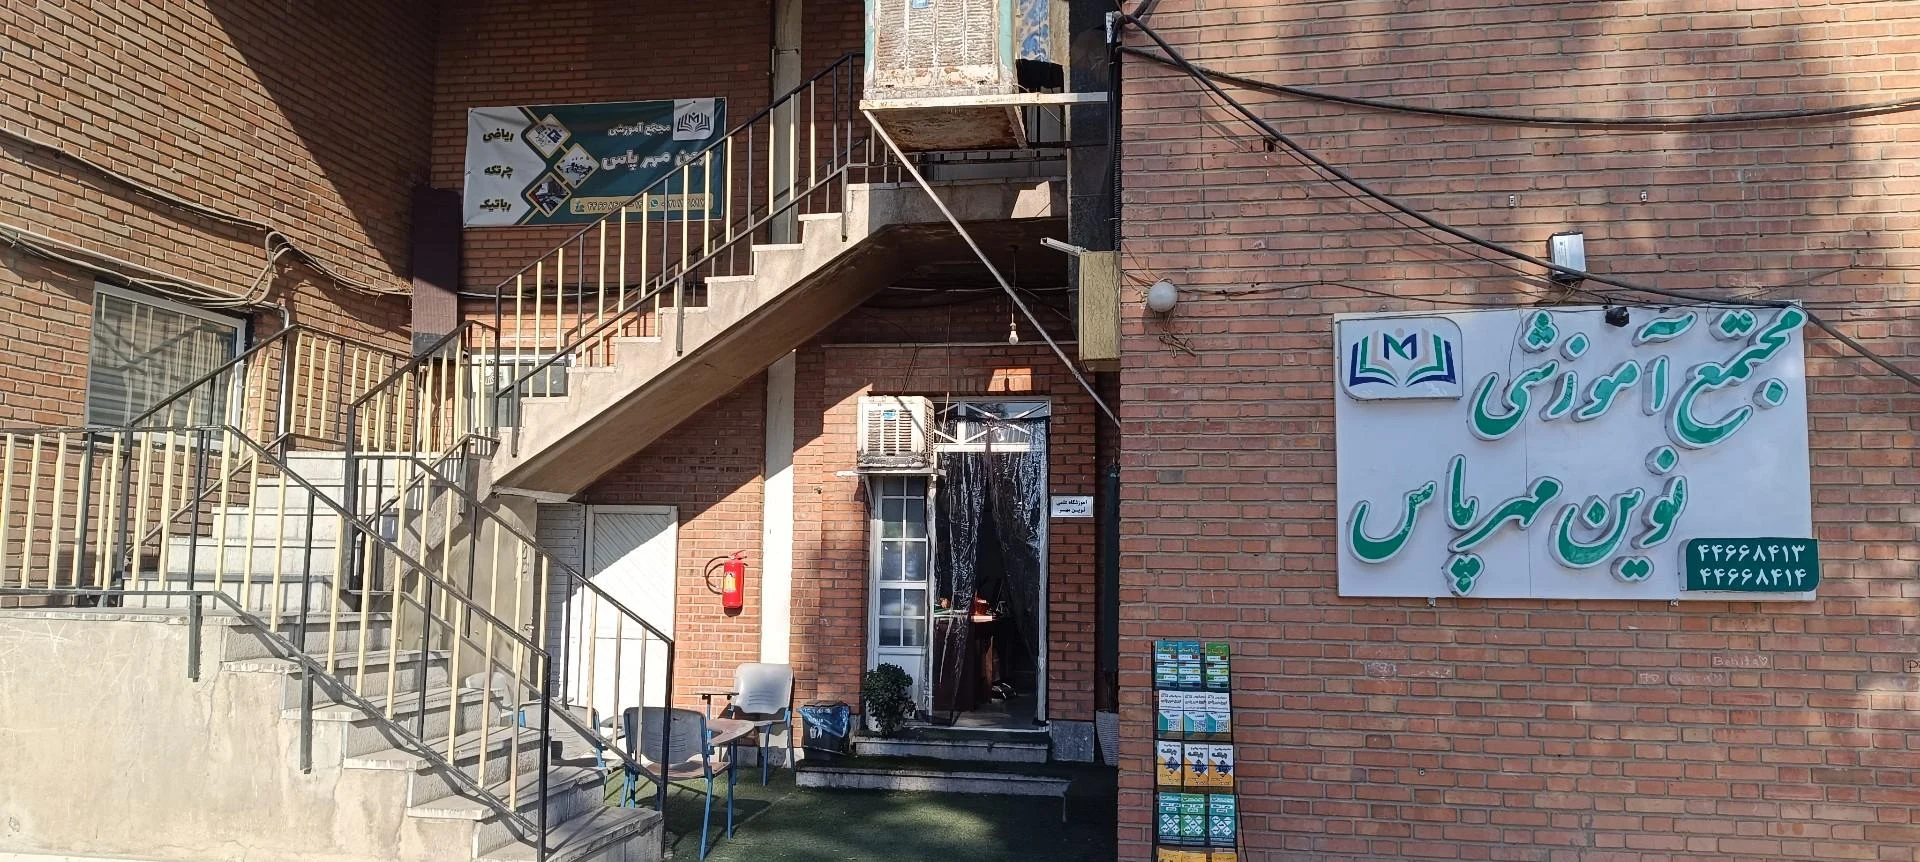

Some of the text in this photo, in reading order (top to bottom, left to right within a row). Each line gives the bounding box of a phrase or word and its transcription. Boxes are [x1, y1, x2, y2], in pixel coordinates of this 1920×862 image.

[482, 127, 515, 142] ریاضی
[607, 122, 671, 136] مجتمع آموزشی
[601, 149, 640, 170] پاس
[640, 151, 672, 168] مهر
[484, 164, 514, 179] چرتکه
[479, 198, 512, 212] رباتیک
[1466, 304, 1809, 449] مجتمع آموزشی
[1345, 445, 1689, 596] نوین مهر پاس
[1697, 543, 1806, 563] ۴۴۶۶۸۴۱۳
[1699, 567, 1808, 587] ۴۴۶۶۸۴۱۴
